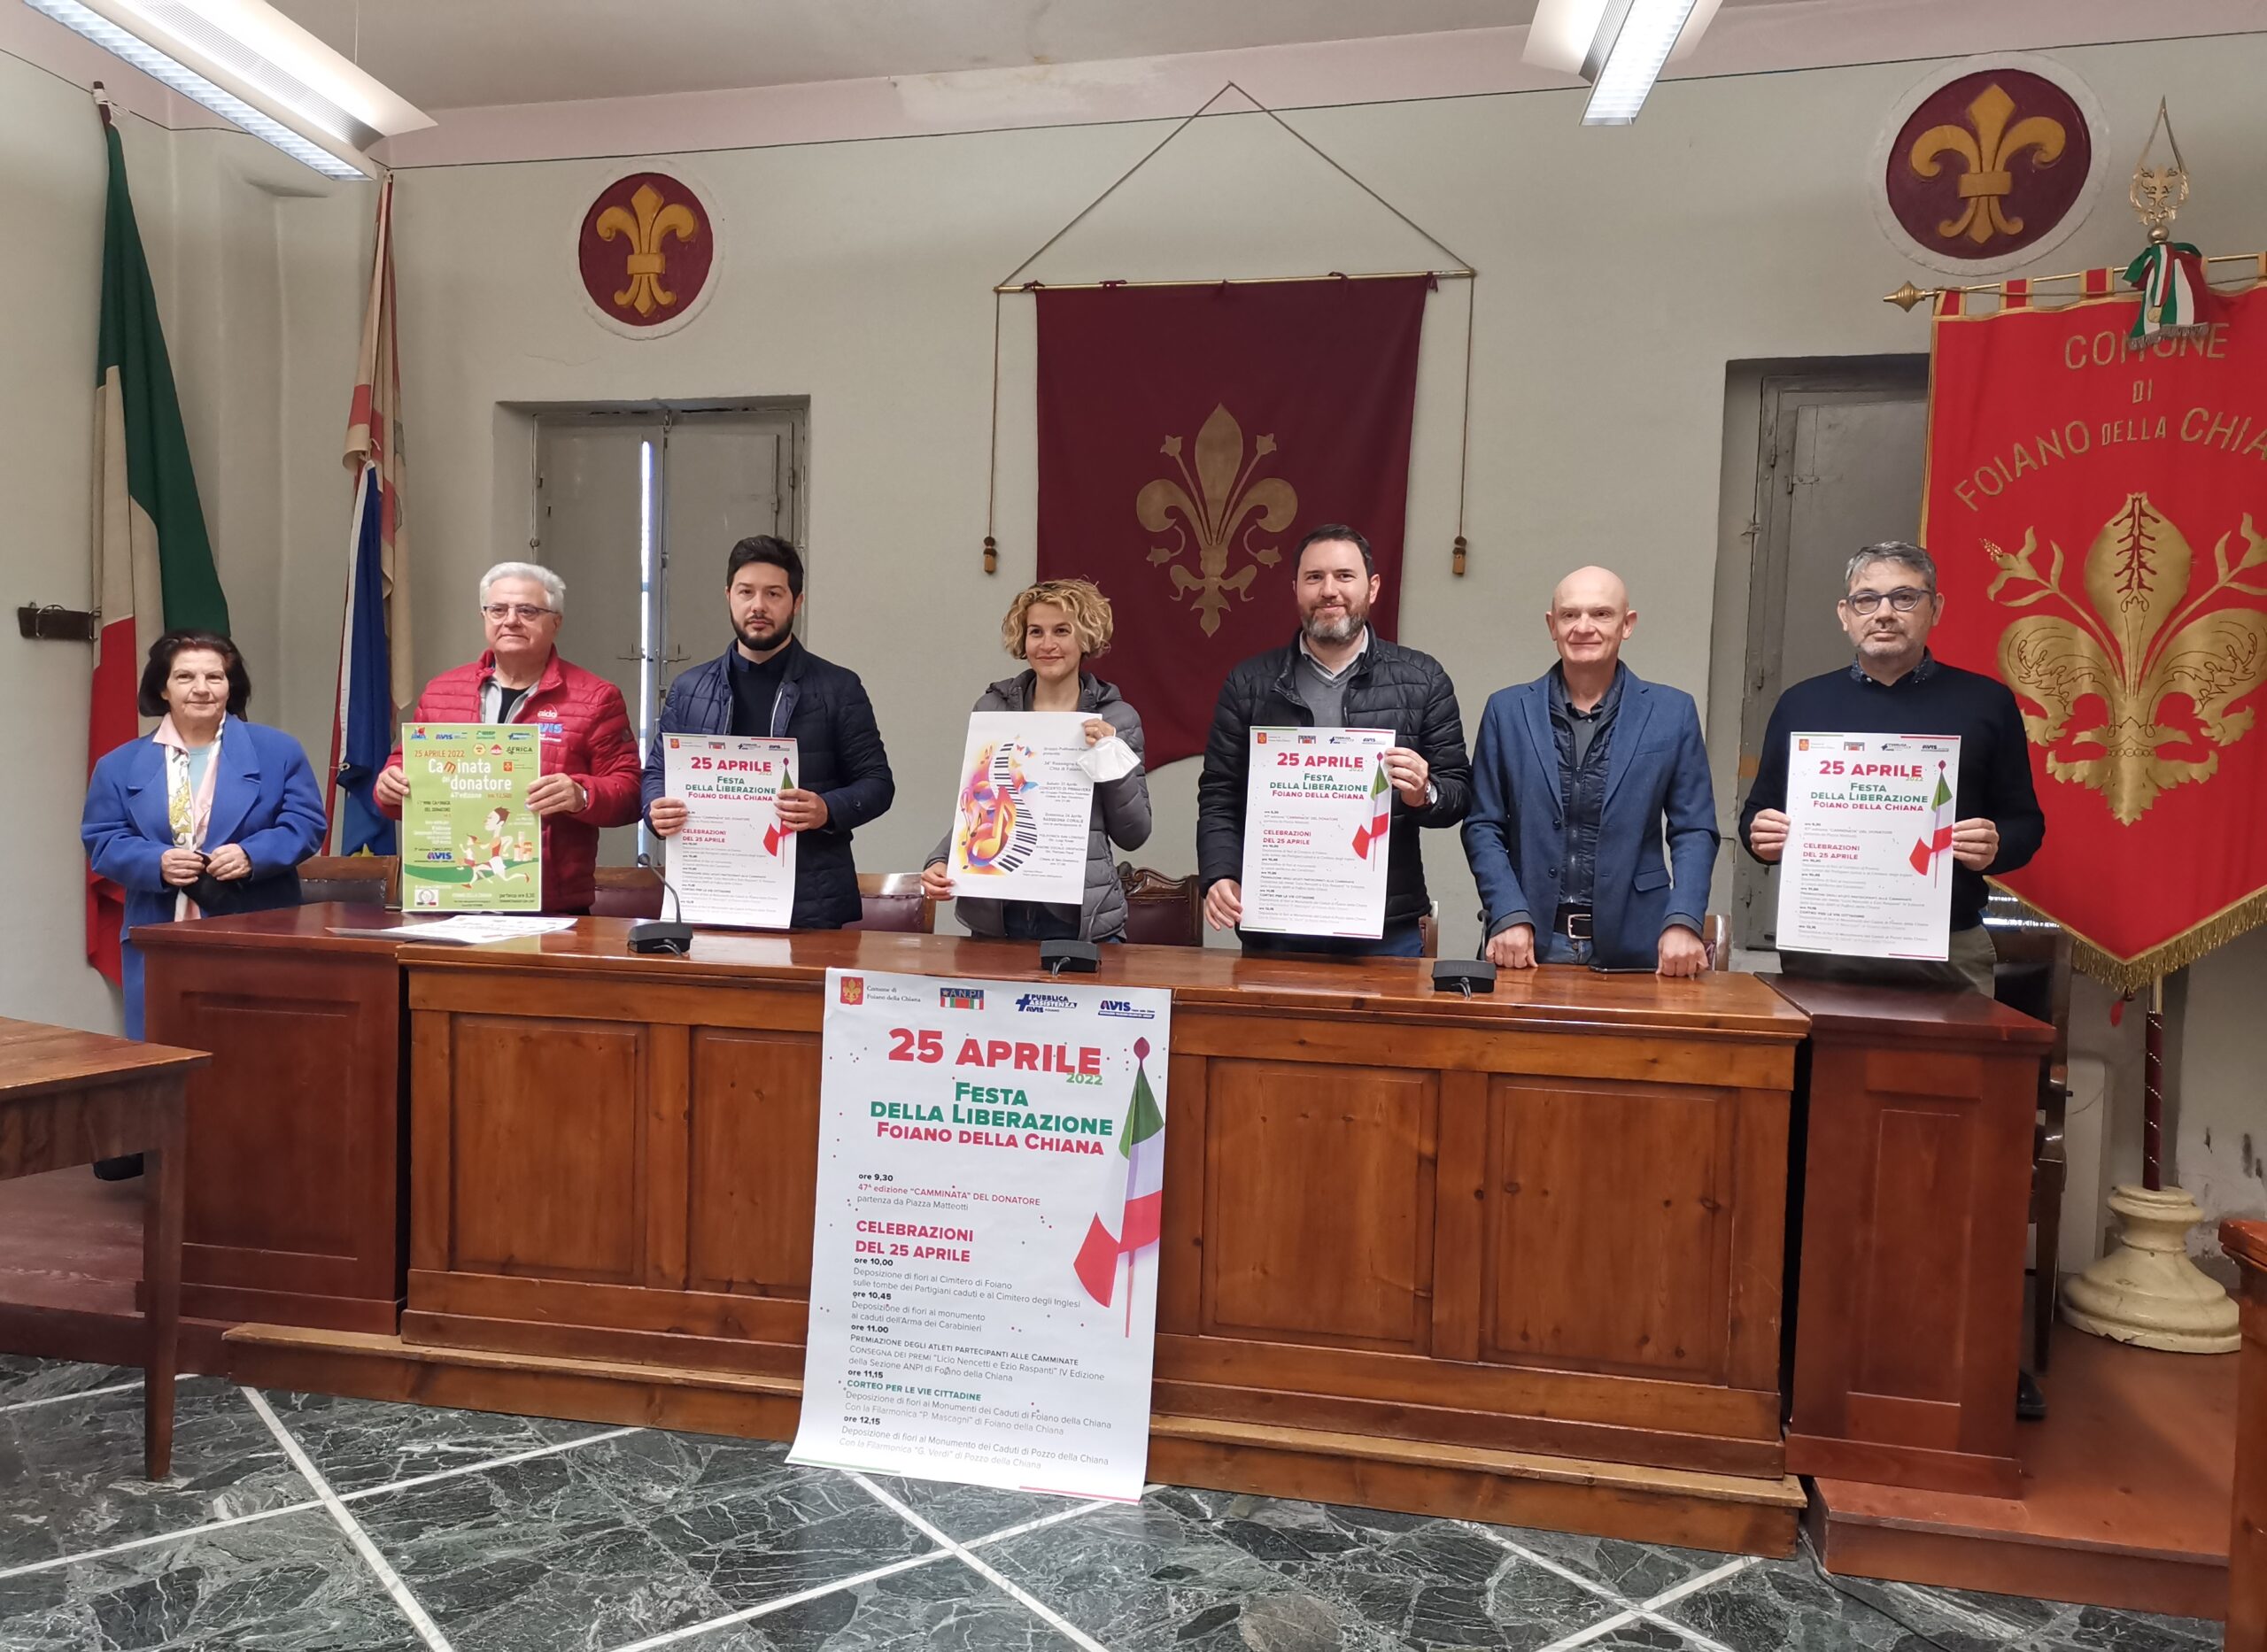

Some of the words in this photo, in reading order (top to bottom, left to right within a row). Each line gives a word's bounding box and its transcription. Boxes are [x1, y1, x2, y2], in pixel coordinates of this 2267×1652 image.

[2132, 379, 2152, 404] DI
[1954, 421, 2091, 512] FOIANO
[2101, 416, 2166, 446] DELLA
[691, 757, 712, 769] 25
[717, 760, 771, 772] APRILE
[1277, 753, 1299, 766] 25
[1304, 756, 1364, 768] APRILE
[1819, 760, 1845, 775] 25
[1851, 763, 1922, 777] APRILE
[450, 775, 512, 790] donatore
[1304, 773, 1334, 782] FESTA
[716, 784, 776, 794] LIBERAZIONE
[1303, 782, 1367, 791] LIBERAZIONE
[1851, 783, 1886, 792] FESTA
[1811, 791, 1845, 800] DELLA
[1849, 792, 1928, 803] LIBERAZIONE
[1885, 803, 1923, 812] CHIANA
[1030, 1000, 1076, 1008] ASSISTENZA
[1101, 1000, 1131, 1011] AVIS
[888, 1028, 944, 1063] 25
[956, 1038, 1101, 1075] APRILE
[1066, 1072, 1103, 1085] 2022
[955, 1082, 1028, 1107] FESTA
[870, 1101, 944, 1123] DELLA
[952, 1104, 1113, 1136] LIBERAZIONE
[877, 1122, 952, 1143] FOIANO
[958, 1131, 1018, 1148] DELLA
[1025, 1133, 1104, 1155] CHIANA
[857, 1195, 891, 1205] partenza
[906, 1198, 931, 1208] Piazza
[933, 1201, 969, 1211] Matteotti
[874, 1185, 908, 1194] edizione
[992, 1195, 1041, 1206] DONATORE
[856, 1220, 973, 1242] CELEBRAZIONI
[855, 1240, 885, 1254] DEL
[890, 1244, 909, 1256] 25
[913, 1246, 970, 1262] APRILE
[854, 1268, 902, 1279] Deposizione
[940, 1276, 973, 1285] Cimitero
[985, 1280, 1012, 1289] Foiano
[873, 1281, 898, 1290] tombe
[915, 1285, 951, 1295] Partigiani
[996, 1293, 1030, 1302] Cimitero
[1032, 1297, 1052, 1307] degli
[1055, 1299, 1080, 1308] Inglesi
[852, 1301, 900, 1312] Deposizione
[939, 1310, 986, 1321] monumento
[939, 1321, 982, 1332] Carabinieri
[850, 1334, 901, 1346] PREMIAZIONE
[904, 1340, 926, 1349] DEGLI
[928, 1343, 953, 1352] ATLETI
[956, 1346, 1009, 1358] PARTECIPANTI
[1032, 1354, 1079, 1365] CAMMINATE
[850, 1346, 892, 1356] CONSEGNA
[957, 1356, 990, 1368] Nencetti
[1001, 1362, 1017, 1370] Ezio
[1070, 1370, 1104, 1381] Edizione
[870, 1359, 901, 1370] Sezione
[903, 1363, 923, 1371] ANPI
[985, 1371, 1013, 1381] Chiana
[864, 1370, 883, 1378] 11,15
[847, 1379, 883, 1390] CORTEO
[886, 1384, 902, 1393] PER
[934, 1389, 981, 1401] CITTADINE
[860, 1417, 880, 1425] 12,15
